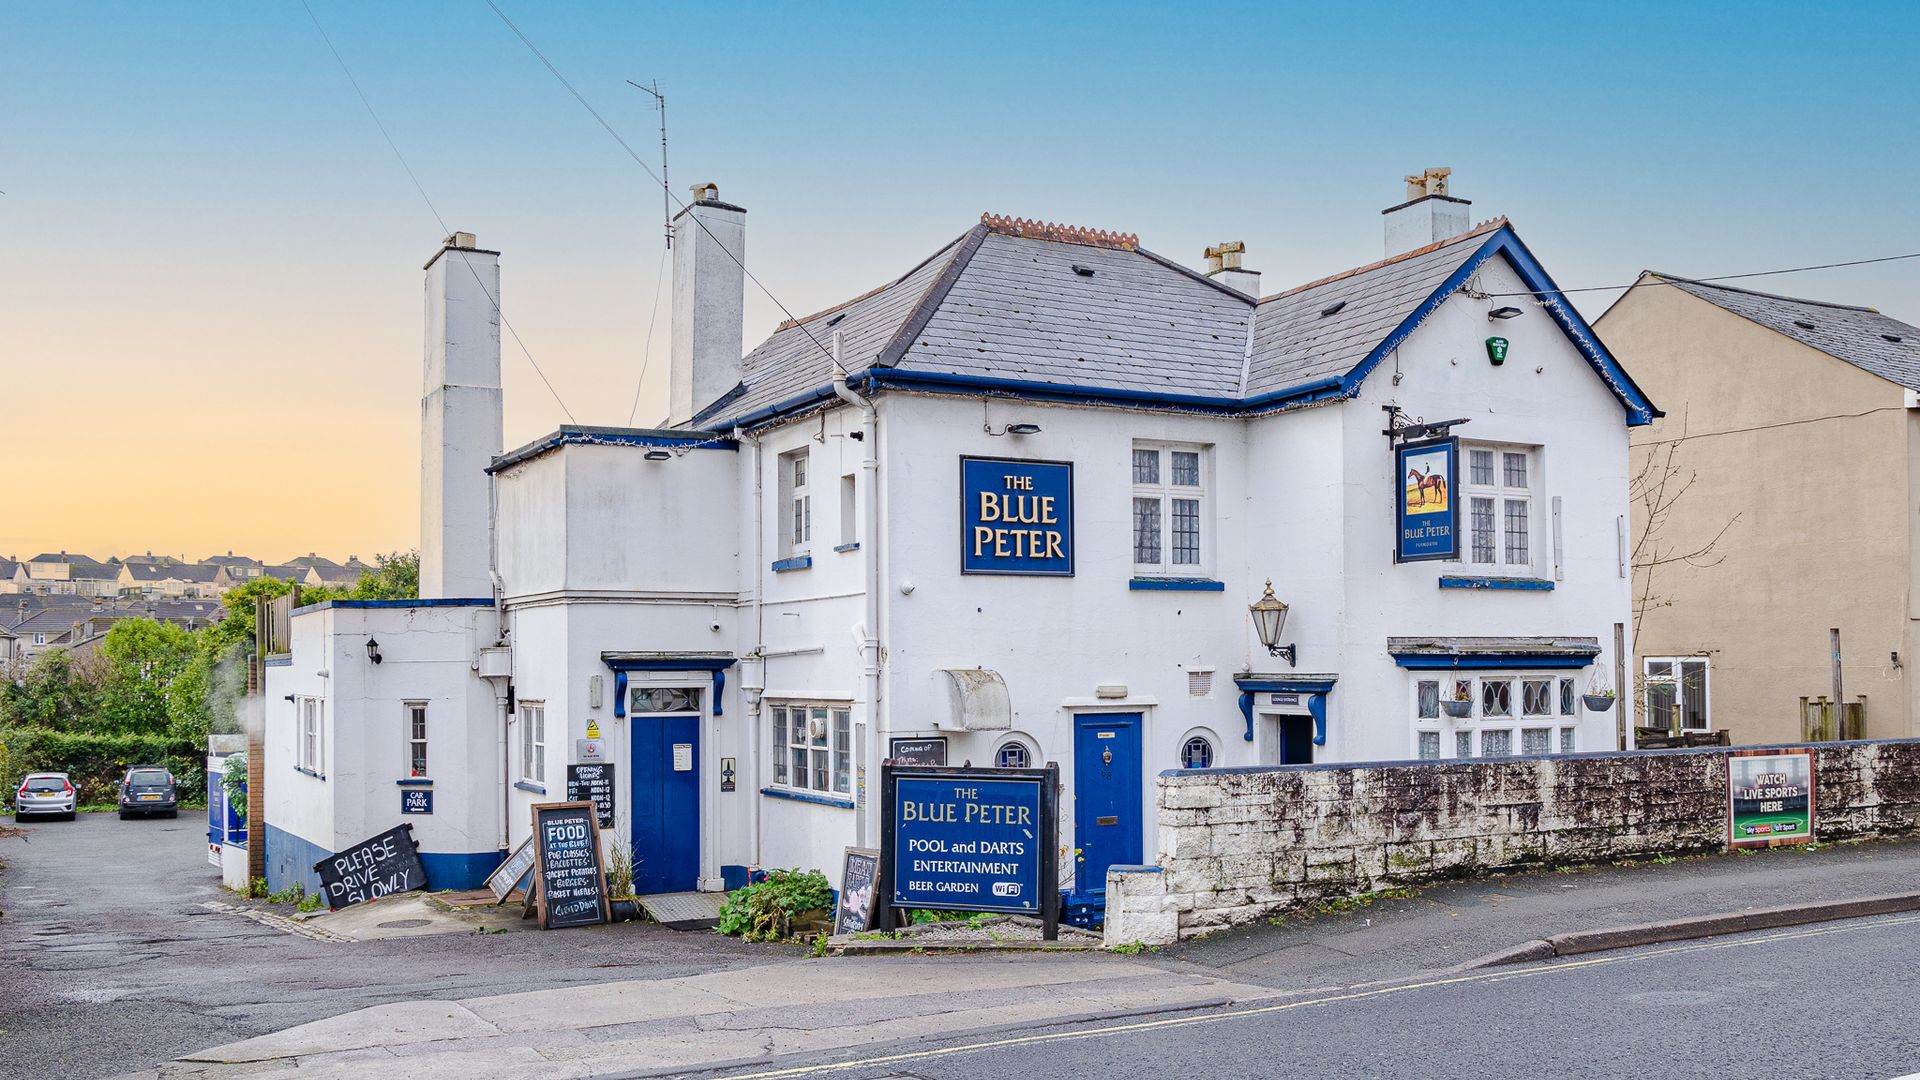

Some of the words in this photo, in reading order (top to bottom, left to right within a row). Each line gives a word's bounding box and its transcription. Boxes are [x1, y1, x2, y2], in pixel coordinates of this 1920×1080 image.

[1003, 475, 1034, 490] THE
[980, 491, 1058, 524] BLUE
[1404, 528, 1425, 539] BLUE
[1426, 525, 1450, 537] PETER
[974, 526, 1065, 558] PETER
[576, 766, 603, 775] OPENING
[1756, 773, 1786, 785] WATCH
[409, 791, 424, 799] CAR
[954, 788, 978, 800] THE
[1744, 788, 1764, 800] LIVE
[1765, 786, 1798, 799] SPORTS
[406, 798, 428, 807] PARK
[1760, 801, 1783, 813] HERE
[903, 801, 958, 822] BLUE
[964, 803, 1032, 825] PETER
[564, 817, 584, 825] PETER
[548, 825, 586, 842] FOOD
[1755, 825, 1771, 833] sports
[909, 839, 948, 853] POOL
[951, 841, 976, 854] and
[980, 841, 1024, 855] DARTS
[334, 835, 397, 876] PLEASE
[545, 869, 569, 880] JACKET
[913, 860, 1019, 875] ENTERTAINMENT
[330, 864, 380, 897] DRIVE
[348, 868, 409, 903] SLOWLY
[909, 881, 934, 891] BEER
[936, 882, 979, 893] GARDEN
[547, 889, 571, 900] BASKET
